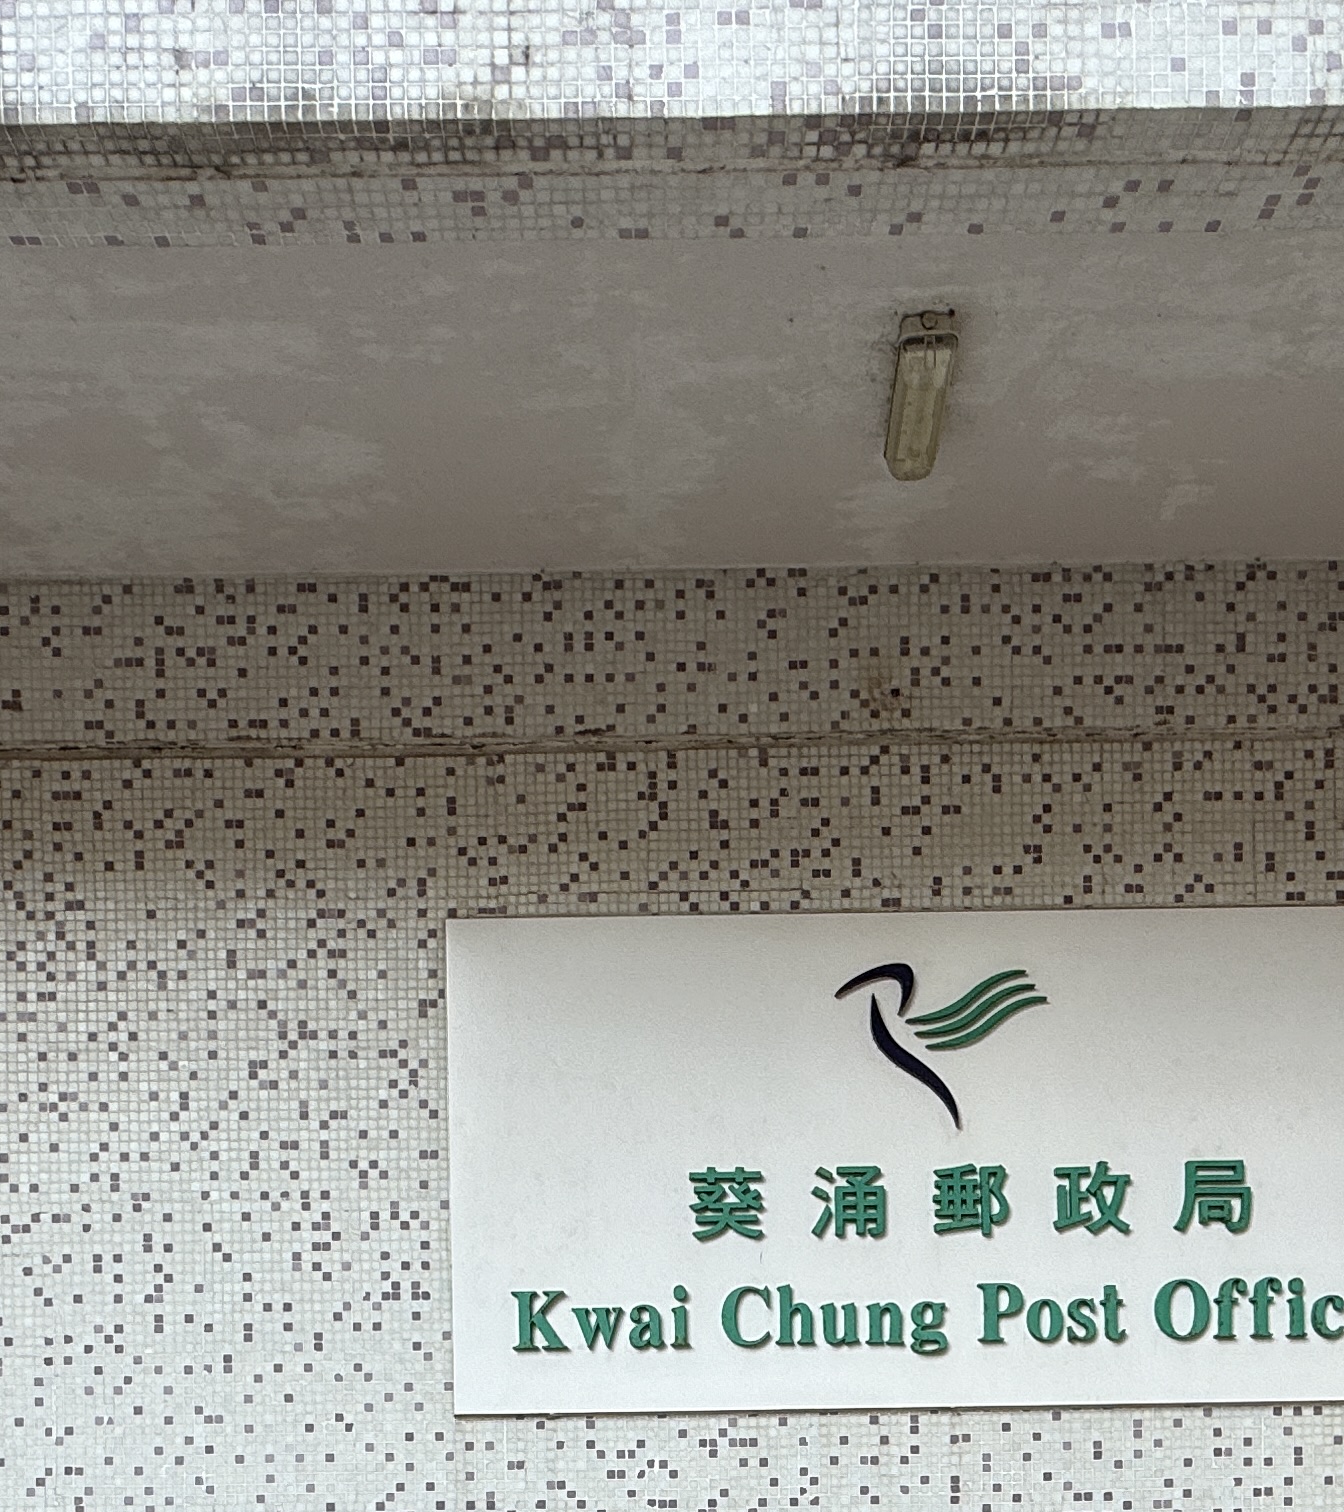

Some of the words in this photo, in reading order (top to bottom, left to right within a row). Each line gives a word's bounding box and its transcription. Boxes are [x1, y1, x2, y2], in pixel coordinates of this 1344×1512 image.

[688, 1159, 1254, 1241] 葵涌郵政局
[510, 1285, 690, 1353] Kwai
[721, 1283, 949, 1355] Chung
[977, 1281, 1126, 1344] Post
